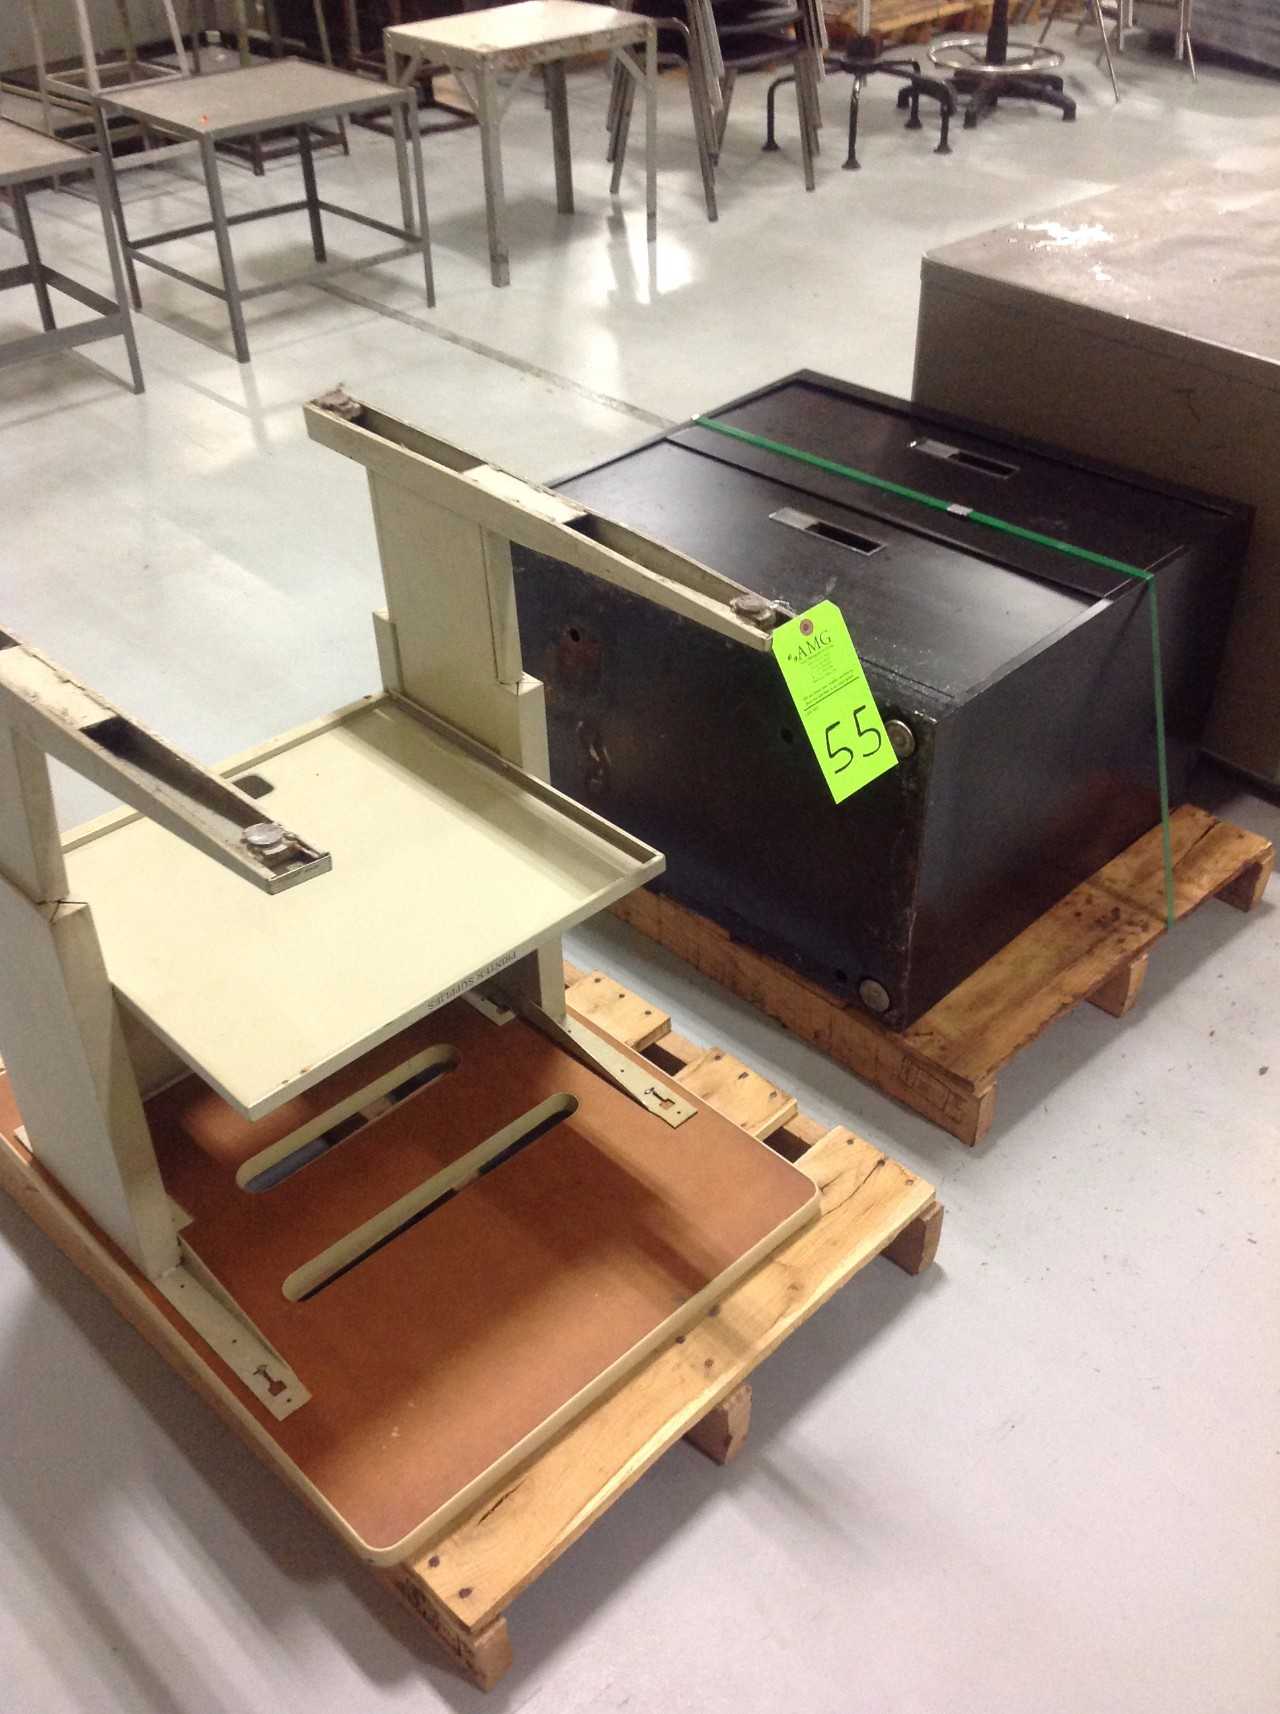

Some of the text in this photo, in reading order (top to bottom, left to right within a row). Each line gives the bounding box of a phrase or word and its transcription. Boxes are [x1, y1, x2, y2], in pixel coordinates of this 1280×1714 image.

[796, 629, 832, 661] AMG
[825, 704, 882, 774] 55
[427, 951, 516, 1009] PRINTER SUPPLIES
